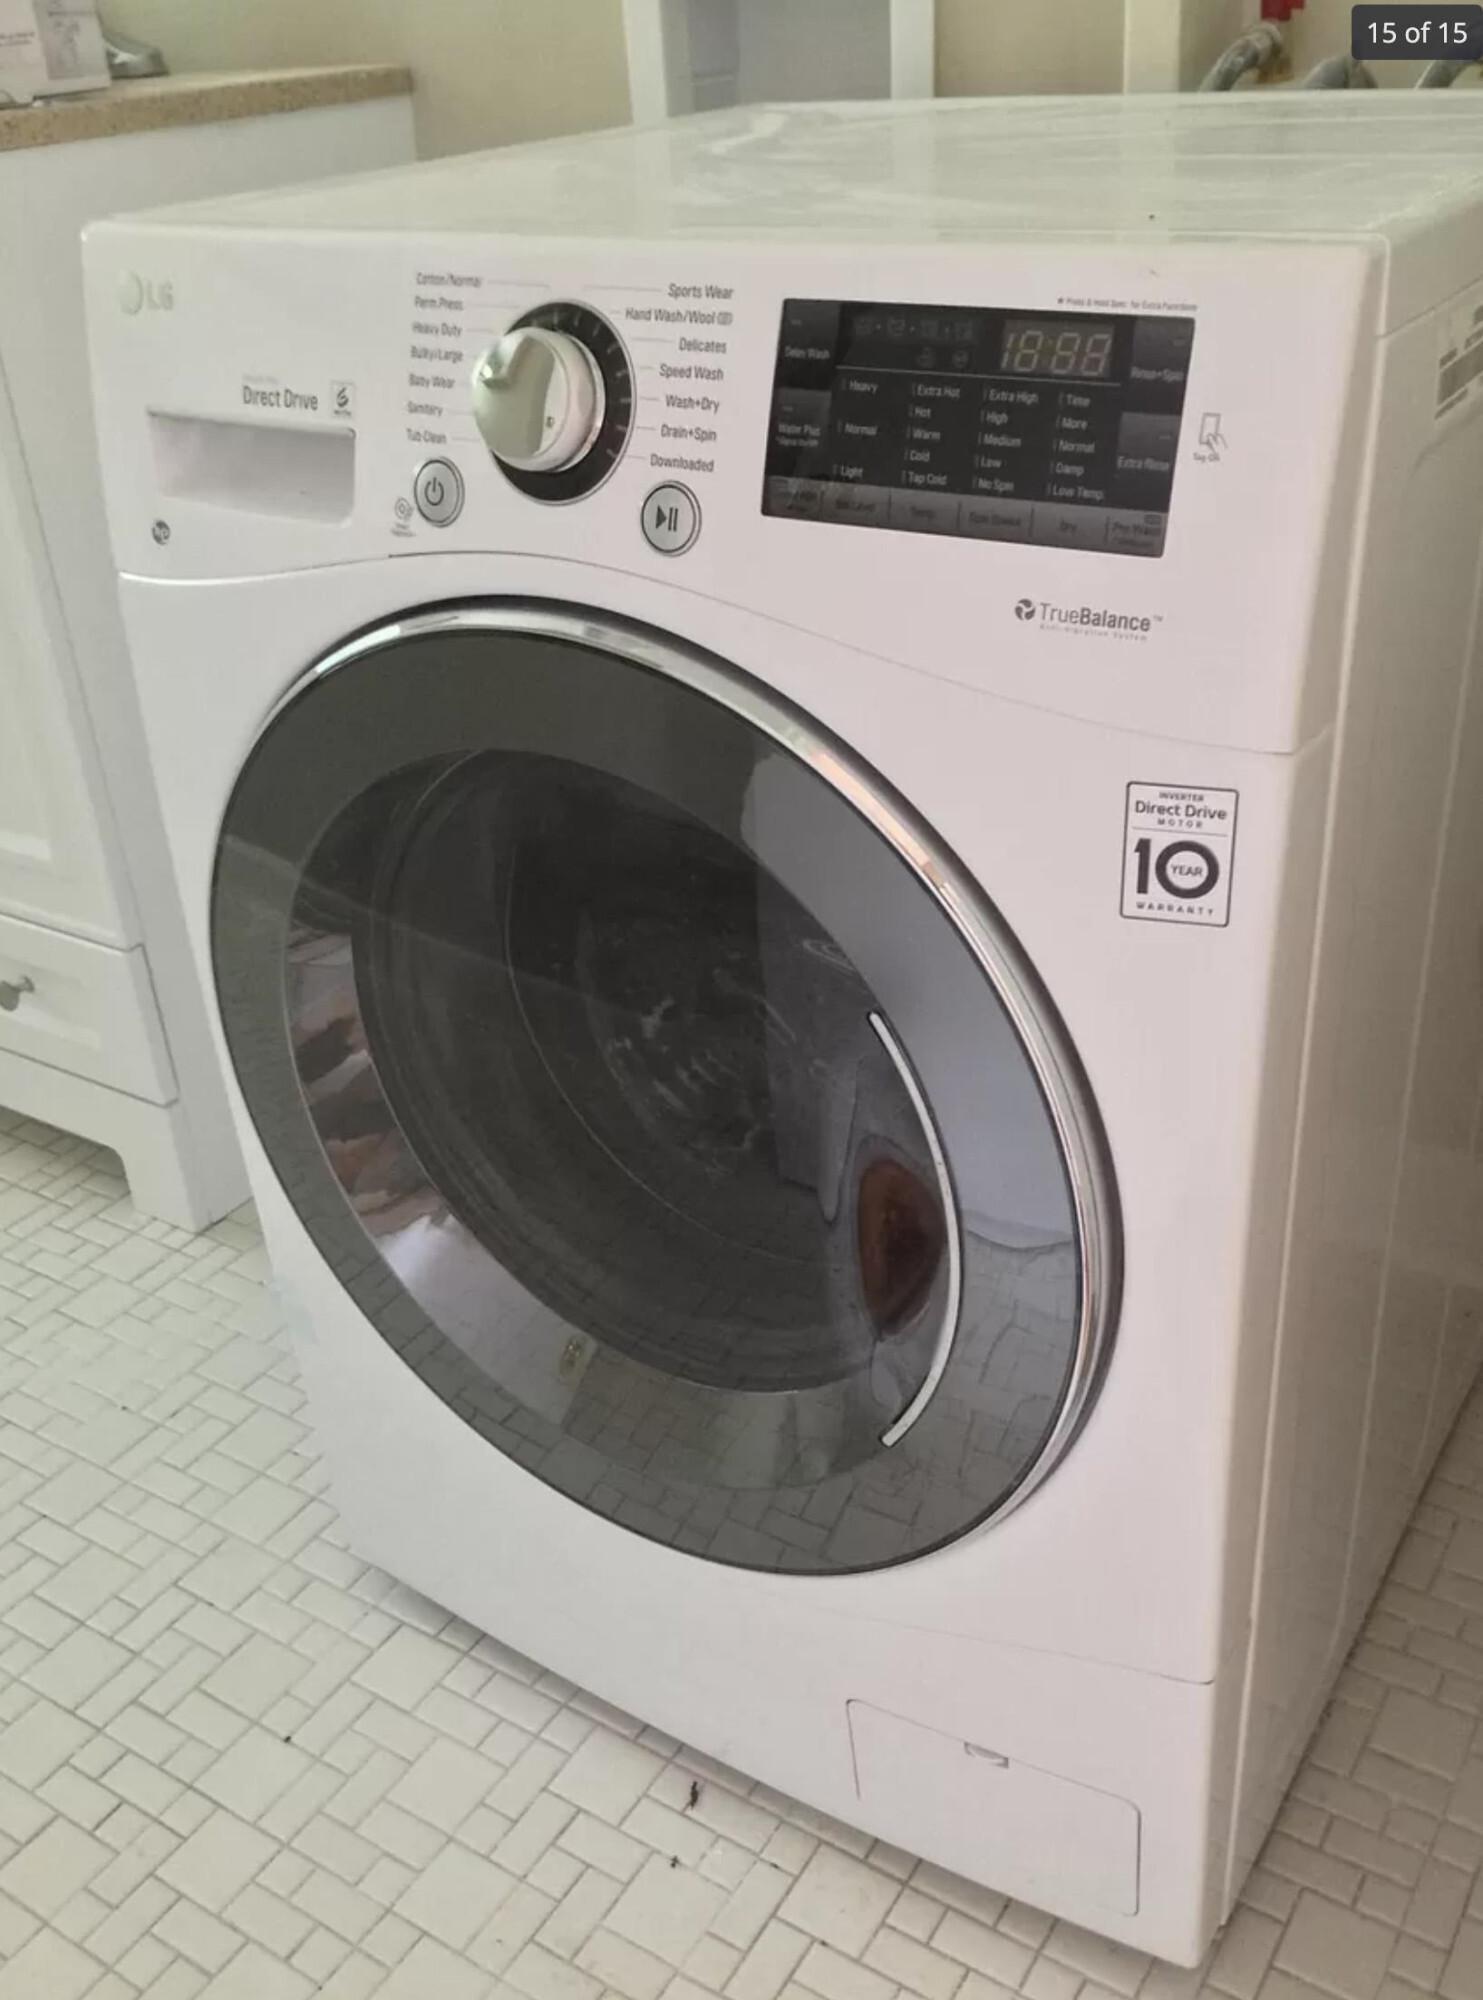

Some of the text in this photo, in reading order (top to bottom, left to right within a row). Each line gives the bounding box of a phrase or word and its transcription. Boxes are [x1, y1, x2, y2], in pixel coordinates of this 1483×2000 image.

[668, 282, 734, 300] Sports Wear
[625, 307, 716, 325] Hand Wash/Wool
[441, 322, 463, 338] Duty
[679, 337, 727, 354] Delicates
[659, 363, 724, 381] Speed Wash
[408, 373, 455, 389] Baby Wear
[849, 380, 879, 395] Heavy
[243, 385, 319, 411] Direct Drive
[665, 394, 720, 415] Wash+Dry
[989, 389, 1039, 406] Extra High
[845, 422, 878, 437] Normal
[1061, 417, 1088, 431] More
[660, 424, 717, 443] Drain+Spin
[983, 433, 1022, 448] Medium
[1059, 440, 1096, 454] Normal
[650, 453, 715, 473] Downloaded
[909, 449, 930, 462] Cold
[841, 464, 864, 479] Light
[927, 473, 948, 486] Cold
[1040, 602, 1152, 632] TrueBalance
[1159, 791, 1205, 802] INVERTER
[1135, 800, 1228, 820] Direct Drive
[1157, 817, 1203, 829] MOTOR
[1134, 837, 1221, 900] 10
[1170, 864, 1204, 878] YEAR
[1136, 901, 1214, 916] WARRANTY
